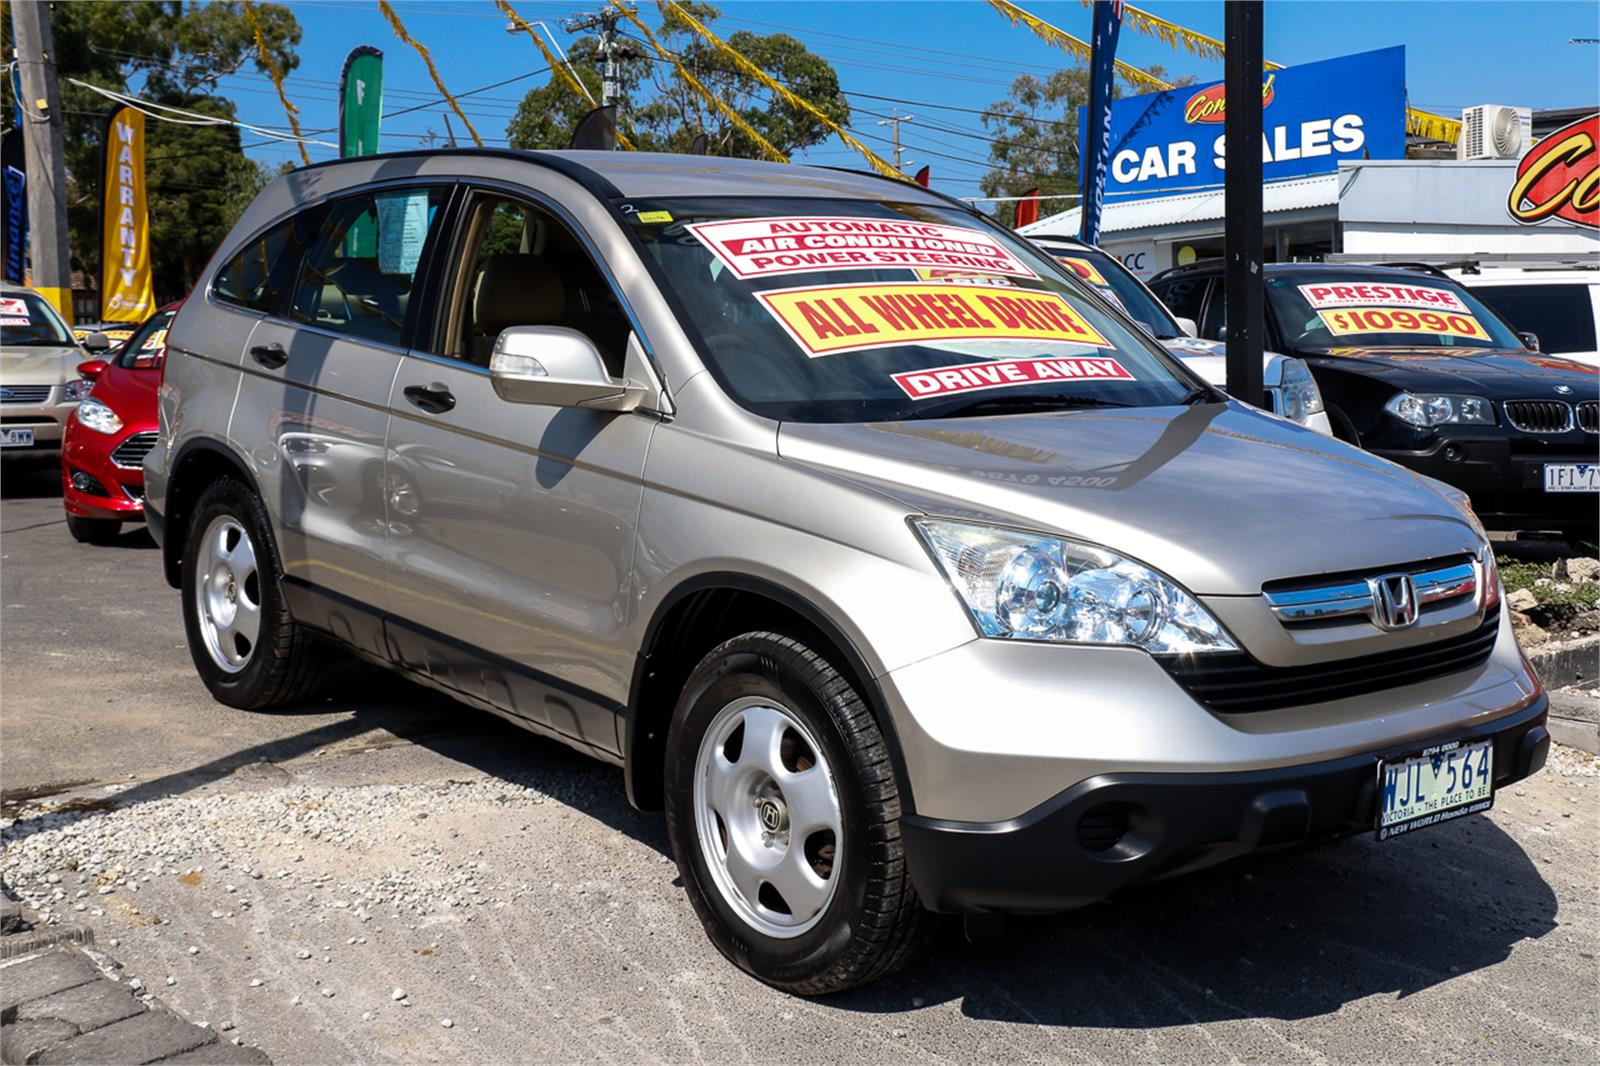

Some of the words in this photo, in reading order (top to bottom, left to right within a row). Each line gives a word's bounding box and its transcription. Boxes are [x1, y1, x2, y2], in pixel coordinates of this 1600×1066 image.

[1184, 74, 1275, 124] Cond
[1112, 140, 1197, 183] CAR
[116, 121, 137, 287] WARRANTY
[769, 221, 944, 237] AUTOMATIC
[740, 237, 797, 254] AIR
[806, 236, 998, 257] CONDITIONED
[750, 251, 876, 269] POWER
[878, 251, 1016, 271] STEERING
[1309, 286, 1458, 306] PRESTIGE
[794, 297, 880, 340] ALL
[861, 292, 996, 331] WHEEL
[980, 294, 1089, 336] DRIVE
[1333, 310, 1477, 336] $10990
[907, 363, 1028, 395] DRIVE
[1035, 359, 1128, 380] AWAY
[1382, 761, 1425, 813] WJL
[1446, 744, 1489, 794] 564
[1381, 806, 1415, 824] VICTORIA
[1424, 800, 1438, 811] THE
[1440, 792, 1462, 806] PLACE
[1466, 790, 1474, 799] TO
[1388, 825, 1410, 836] NEW
[1410, 813, 1440, 830] WORLD
